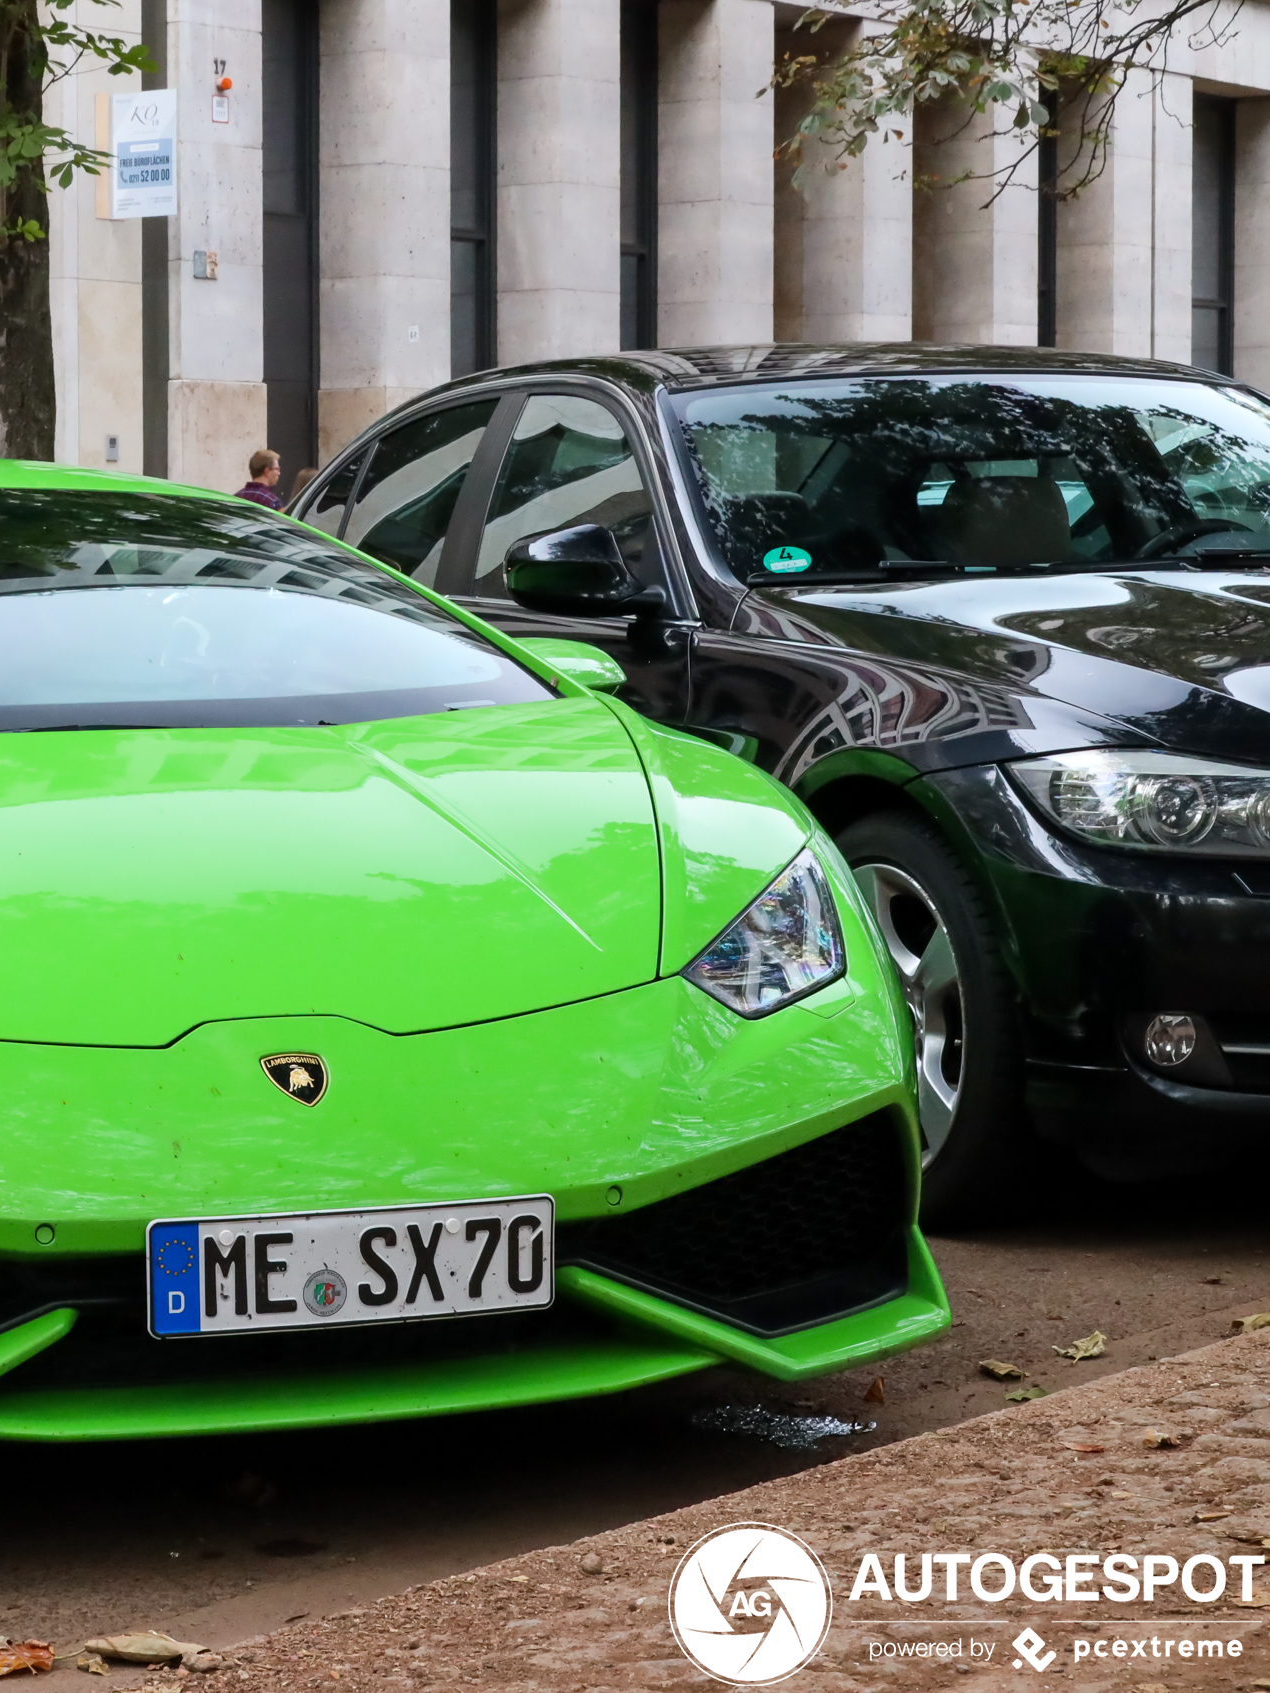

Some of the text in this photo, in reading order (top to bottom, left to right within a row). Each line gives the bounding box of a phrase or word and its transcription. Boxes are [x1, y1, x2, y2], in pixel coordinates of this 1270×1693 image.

[213, 58, 226, 75] 17
[119, 154, 170, 168] FREIE BÜROFLÄCHEN
[140, 170, 150, 183] 52
[150, 169, 160, 182] 00
[160, 168, 170, 181] 00
[779, 547, 794, 560] 4
[265, 1056, 320, 1068] LAMBORGHINI
[203, 1232, 298, 1318] ME
[168, 1291, 185, 1314] D
